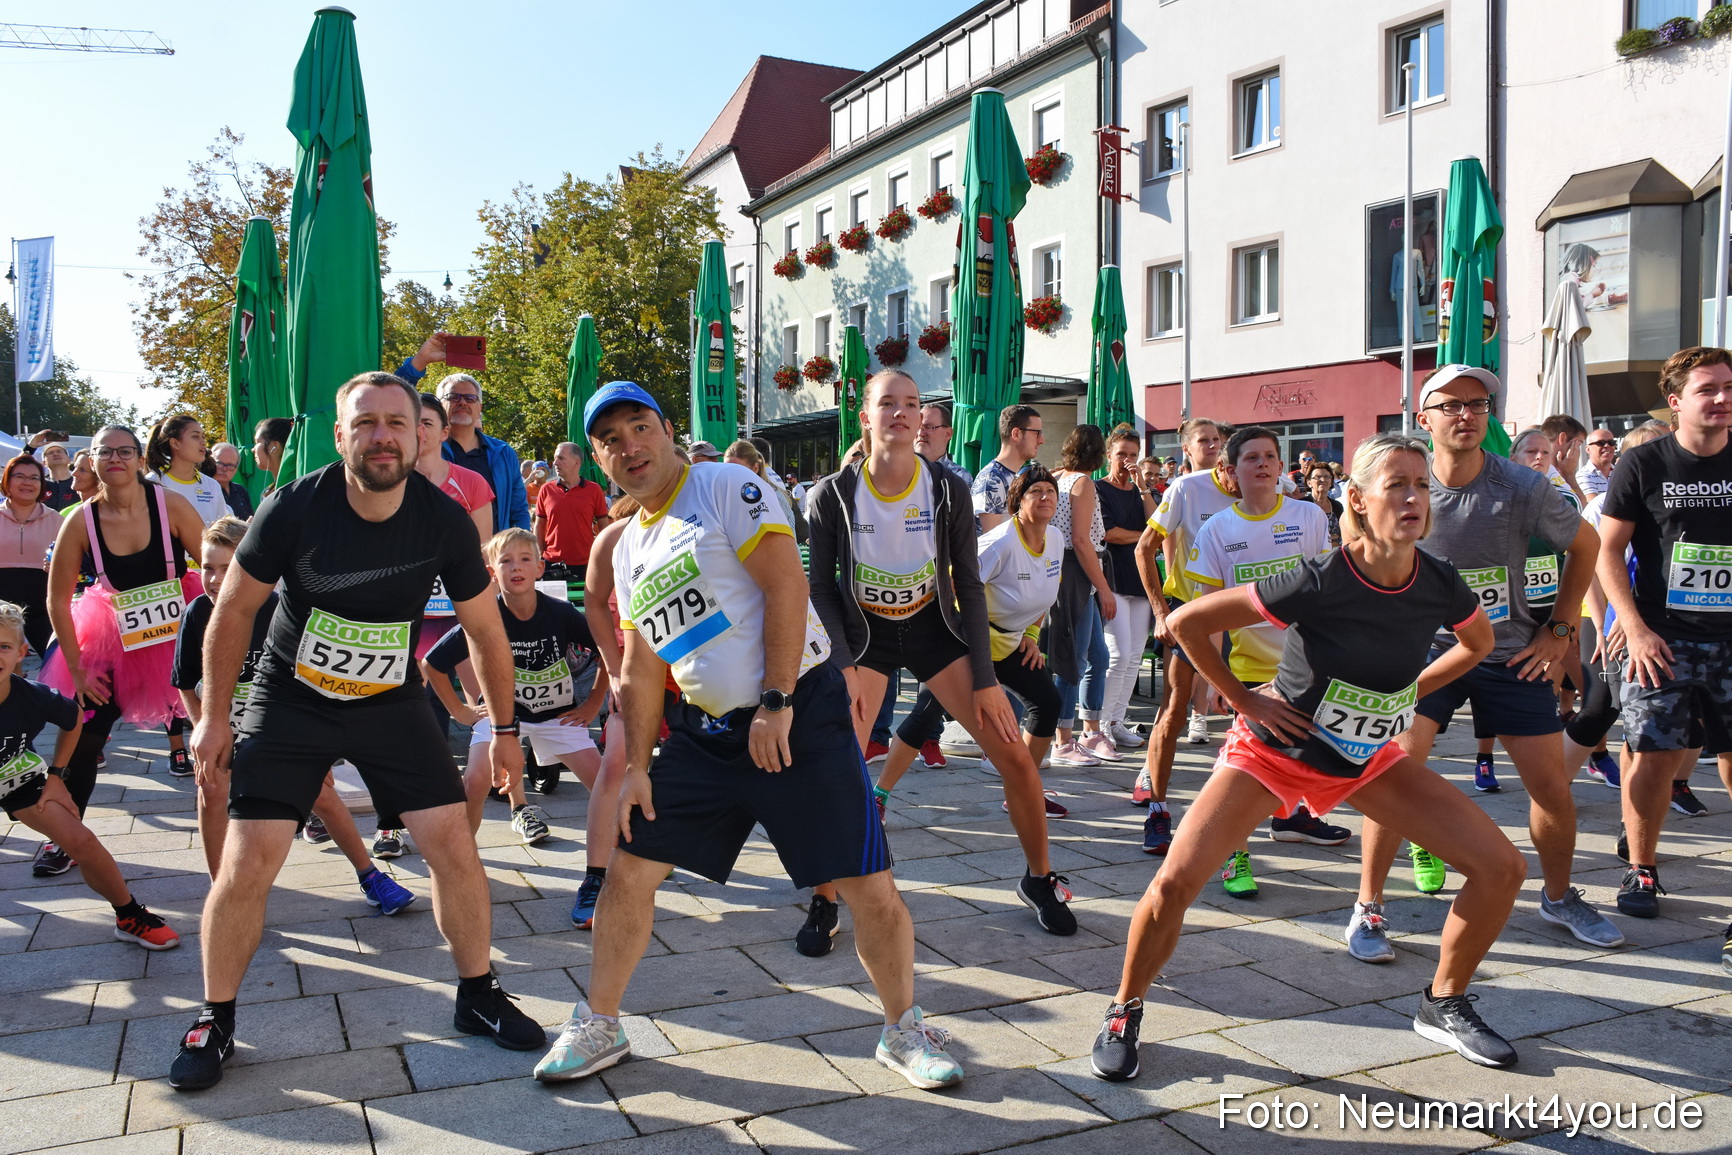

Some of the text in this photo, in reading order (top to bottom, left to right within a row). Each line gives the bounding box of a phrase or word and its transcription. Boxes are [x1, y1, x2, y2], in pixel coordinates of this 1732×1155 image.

[1104, 142, 1117, 193] Achatz
[1662, 480, 1732, 496] Reebok
[1663, 497, 1732, 508] WEIGHTLIF
[905, 508, 919, 519] 20
[670, 520, 682, 535] 20
[670, 521, 702, 543] Neumarkter
[1273, 524, 1285, 533] 20
[671, 532, 697, 552] Stadtlauf
[1225, 542, 1247, 551] BOCK
[1274, 537, 1298, 545] Stadtlauf
[1680, 546, 1732, 563] BOC
[862, 565, 930, 587] BOCK
[1238, 556, 1301, 580] BOCK
[631, 557, 694, 615] BOCK
[1680, 568, 1731, 589] 210
[117, 582, 178, 608] BOCK
[864, 583, 926, 604] 5031
[1684, 594, 1732, 605] NICOLA
[124, 601, 180, 629] 5110
[642, 588, 706, 645] 2779
[868, 599, 925, 615] VICTORIA
[143, 626, 174, 640] ALINA
[314, 614, 402, 646] BOCK
[309, 641, 396, 679] 5277
[320, 676, 370, 696] MARC
[525, 700, 555, 709] AKOB
[1333, 686, 1413, 713] BOCK
[1325, 708, 1405, 739] 2150
